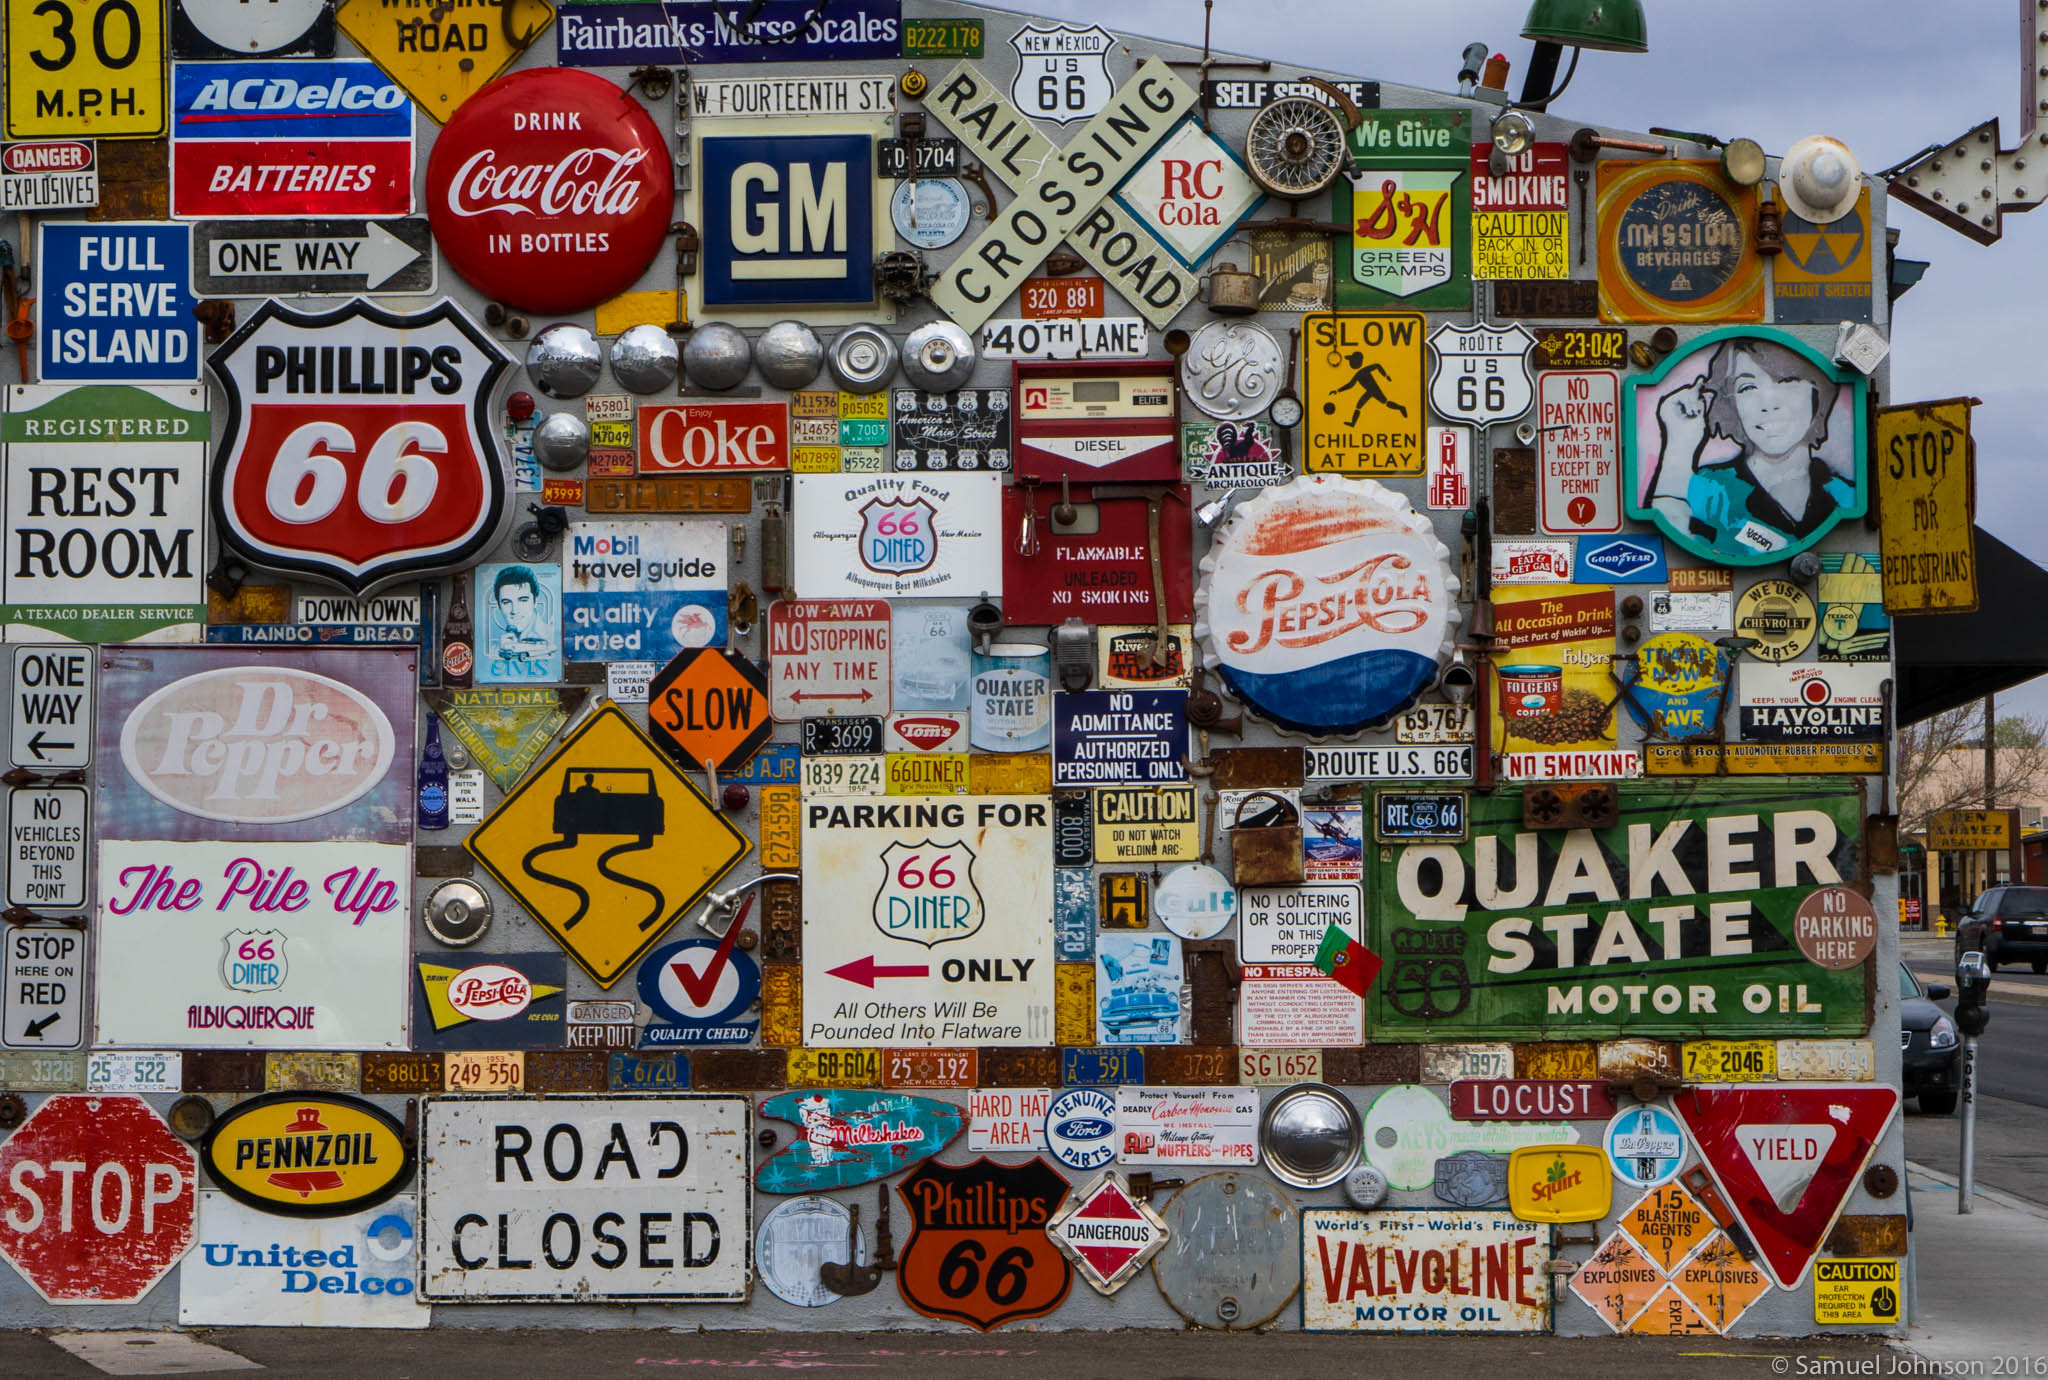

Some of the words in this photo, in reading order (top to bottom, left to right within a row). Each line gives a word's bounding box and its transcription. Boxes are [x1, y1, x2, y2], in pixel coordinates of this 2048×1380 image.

[29, 0, 141, 71] 30
[398, 22, 488, 53] ROAD
[804, 9, 898, 44] Scales
[1025, 36, 1050, 51] NEW
[1056, 35, 1100, 50] MEXICO
[36, 88, 145, 118] M.P.H.
[190, 78, 407, 111] ACDelco
[694, 86, 712, 114] W.
[720, 84, 848, 113] FOURTEENTH
[860, 81, 887, 110] ST.
[1039, 76, 1086, 110] 66
[515, 112, 582, 131] DRINK
[1356, 127, 1392, 147] We
[1397, 120, 1450, 147] Give
[12, 147, 83, 167] DANGER
[4, 176, 95, 206] EXPLOSIVES
[209, 165, 376, 193] BATTERIES
[448, 148, 649, 217] Coca-Cola
[937, 73, 1031, 176] RAIL
[1075, 204, 1181, 308] ROAD
[955, 78, 1175, 304] CROSSING
[1161, 160, 1224, 200] RC
[1474, 176, 1565, 206] SMOKING
[731, 162, 847, 255] GM
[1159, 202, 1221, 226] Cola
[1477, 214, 1561, 236] CAUTION
[489, 234, 511, 253] IN
[521, 233, 609, 253] BOTTLES
[1478, 238, 1515, 252] BACK
[1522, 239, 1537, 251] IN
[1543, 239, 1562, 250] OR
[218, 243, 282, 272] ONE
[296, 242, 360, 271] WAY
[1360, 252, 1444, 263] GREEN
[1478, 253, 1508, 265] PULL
[1515, 253, 1540, 265] OUT
[1546, 252, 1563, 264] ON
[1360, 265, 1446, 277] STAMPS
[1478, 266, 1523, 278] GREEN
[1527, 266, 1561, 278] ONLY
[1775, 285, 1820, 297] FALLOUT
[1825, 284, 1871, 297] SHELTER
[1081, 325, 1139, 352] LANE
[1315, 321, 1412, 347] SLOW
[255, 345, 463, 395] PHILLIPS
[1568, 379, 1589, 399] NO
[1545, 403, 1614, 425] PARKING
[25, 419, 190, 436] REGISTERED
[649, 409, 775, 468] Coke
[1075, 440, 1124, 452] DIESEL
[1314, 433, 1416, 448] CHILDREN
[1557, 444, 1602, 459] MON-FRI
[1321, 453, 1345, 468] AT
[1359, 453, 1413, 468] PLAY
[1889, 431, 1953, 480] STOP
[266, 421, 448, 525] 66
[1208, 462, 1278, 478] ANTIQUE
[1551, 462, 1592, 476] EXCEPT
[1597, 461, 1611, 475] BY
[28, 467, 179, 517] REST
[1207, 477, 1280, 489] ARCHAEOLOGY
[1561, 479, 1599, 494] PERMIT
[1914, 500, 1938, 531] FOR
[14, 529, 194, 578] ROOM
[574, 535, 639, 555] Mobil
[573, 559, 641, 578] travel
[648, 559, 716, 583] guide
[1672, 571, 1697, 586] FOR
[1701, 571, 1730, 585] SALE
[1886, 552, 1968, 586] PEDESTRIANS
[13, 610, 21, 619] A
[26, 609, 77, 620] TEXACO
[82, 609, 135, 620] DEALER
[140, 609, 195, 620] SERVICE
[573, 604, 658, 627] quality
[786, 604, 875, 618] TOW-AWAY
[1744, 617, 1809, 629] CHEVROLET
[574, 630, 641, 651] rated
[773, 623, 807, 652] NO
[810, 628, 887, 651] STOPPING
[783, 662, 824, 681] ANY
[833, 662, 879, 681] TIME
[976, 679, 1045, 698] QUAKER
[666, 687, 753, 731] SLOW
[986, 698, 1034, 717] STATE
[1110, 694, 1133, 711] NO
[1071, 713, 1173, 732] ADMITTANCE
[1753, 707, 1881, 726] HAVOLINE
[831, 725, 872, 750] 3699
[1075, 741, 1170, 759] AUTHORIZED
[1057, 763, 1143, 780] PERSONNEL
[1149, 762, 1185, 780] ONLY
[1318, 751, 1378, 775] ROUTE
[1388, 752, 1426, 774] U.S.
[1435, 750, 1459, 774] 66
[809, 804, 964, 828] PARKING
[978, 804, 1046, 827] FOR
[1103, 792, 1191, 821] CAUTION
[898, 854, 956, 889] 66
[1397, 810, 1842, 921] QUAKER
[109, 864, 204, 915] The
[216, 857, 311, 913] Pile
[323, 866, 400, 927] Up
[1251, 894, 1270, 909] NO
[1277, 894, 1350, 908] LOITERING
[889, 896, 970, 929] DINER
[1250, 913, 1268, 925] OR
[1277, 912, 1352, 925] SOLICITING
[15, 937, 75, 960] STOP
[1487, 901, 1752, 974] STATE
[15, 966, 49, 977] HERE
[55, 966, 73, 977] ON
[942, 958, 1035, 982] ONLY
[21, 983, 65, 1005] RED
[1548, 985, 1718, 1014] MOTOR
[1743, 984, 1822, 1013] OIL
[187, 1005, 315, 1030] ALBUQUERQUE
[833, 1002, 858, 1019] All
[864, 1002, 926, 1019] Others
[933, 1002, 967, 1018] Will
[972, 1001, 997, 1018] Be
[650, 1028, 700, 1041] QUALITY
[705, 1027, 748, 1039] CHEKD
[811, 1023, 895, 1040] Pounded
[900, 1023, 938, 1039] Into
[943, 1022, 1022, 1039] Flatware
[90, 1061, 111, 1081] 25
[134, 1061, 166, 1083] 522
[450, 1066, 480, 1086] 249
[489, 1064, 520, 1084] 550
[1473, 1084, 1593, 1116] LOCUST
[236, 1132, 377, 1171] PENNZOIL
[495, 1121, 688, 1182] ROAD
[1753, 1138, 1818, 1161] YIELD
[5, 1160, 182, 1235] STOP
[914, 1178, 1047, 1234] Phillips
[452, 1212, 720, 1271] CLOSED
[1068, 1224, 1149, 1242] DANGEROUS
[201, 1244, 358, 1268] United
[282, 1270, 414, 1296] Delco
[939, 1240, 1034, 1306] 66
[1317, 1235, 1537, 1307] VALVOLINE
[1819, 1264, 1895, 1281] CAUTION
